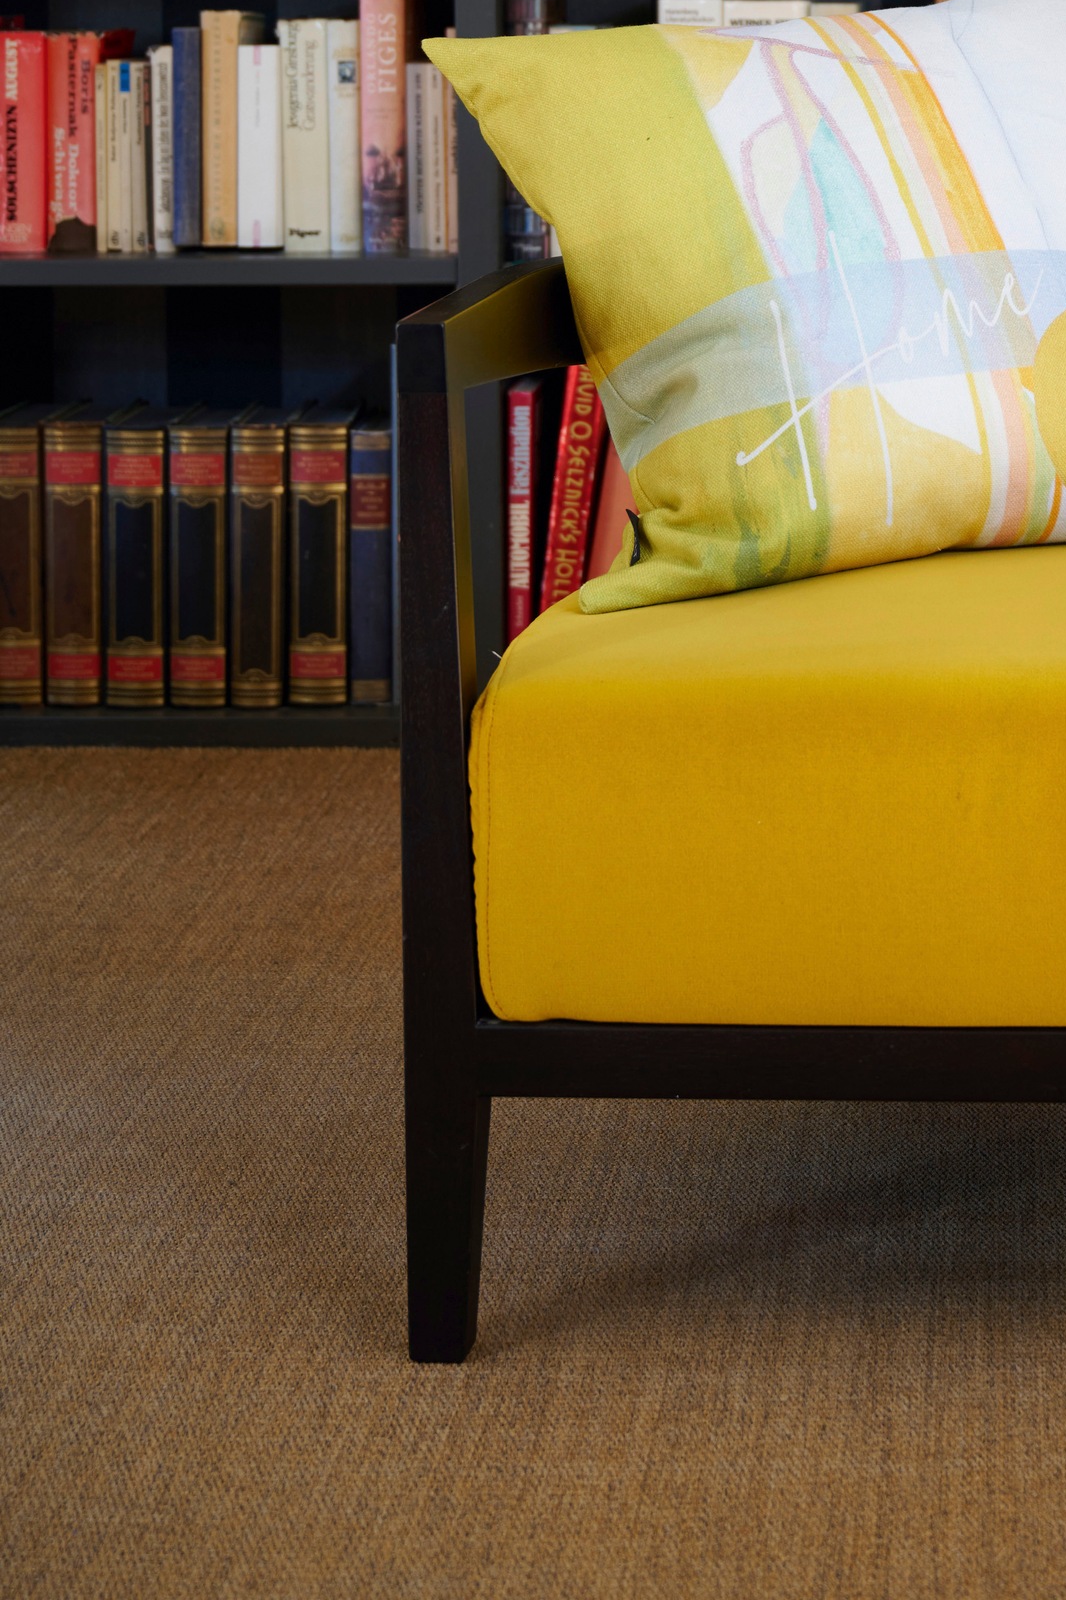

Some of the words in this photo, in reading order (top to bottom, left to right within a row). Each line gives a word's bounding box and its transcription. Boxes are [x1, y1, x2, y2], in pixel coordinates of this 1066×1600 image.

[5, 38, 18, 100] AUGUST
[68, 38, 77, 137] Pasternak
[81, 60, 92, 113] Boris
[378, 12, 397, 93] FIGES
[5, 105, 17, 221] SOLSCHENIZYN
[68, 144, 79, 210] Doktor
[736, 230, 1044, 527] Home
[509, 406, 530, 495] Faszination
[509, 501, 530, 588] AUTOMOBIL
